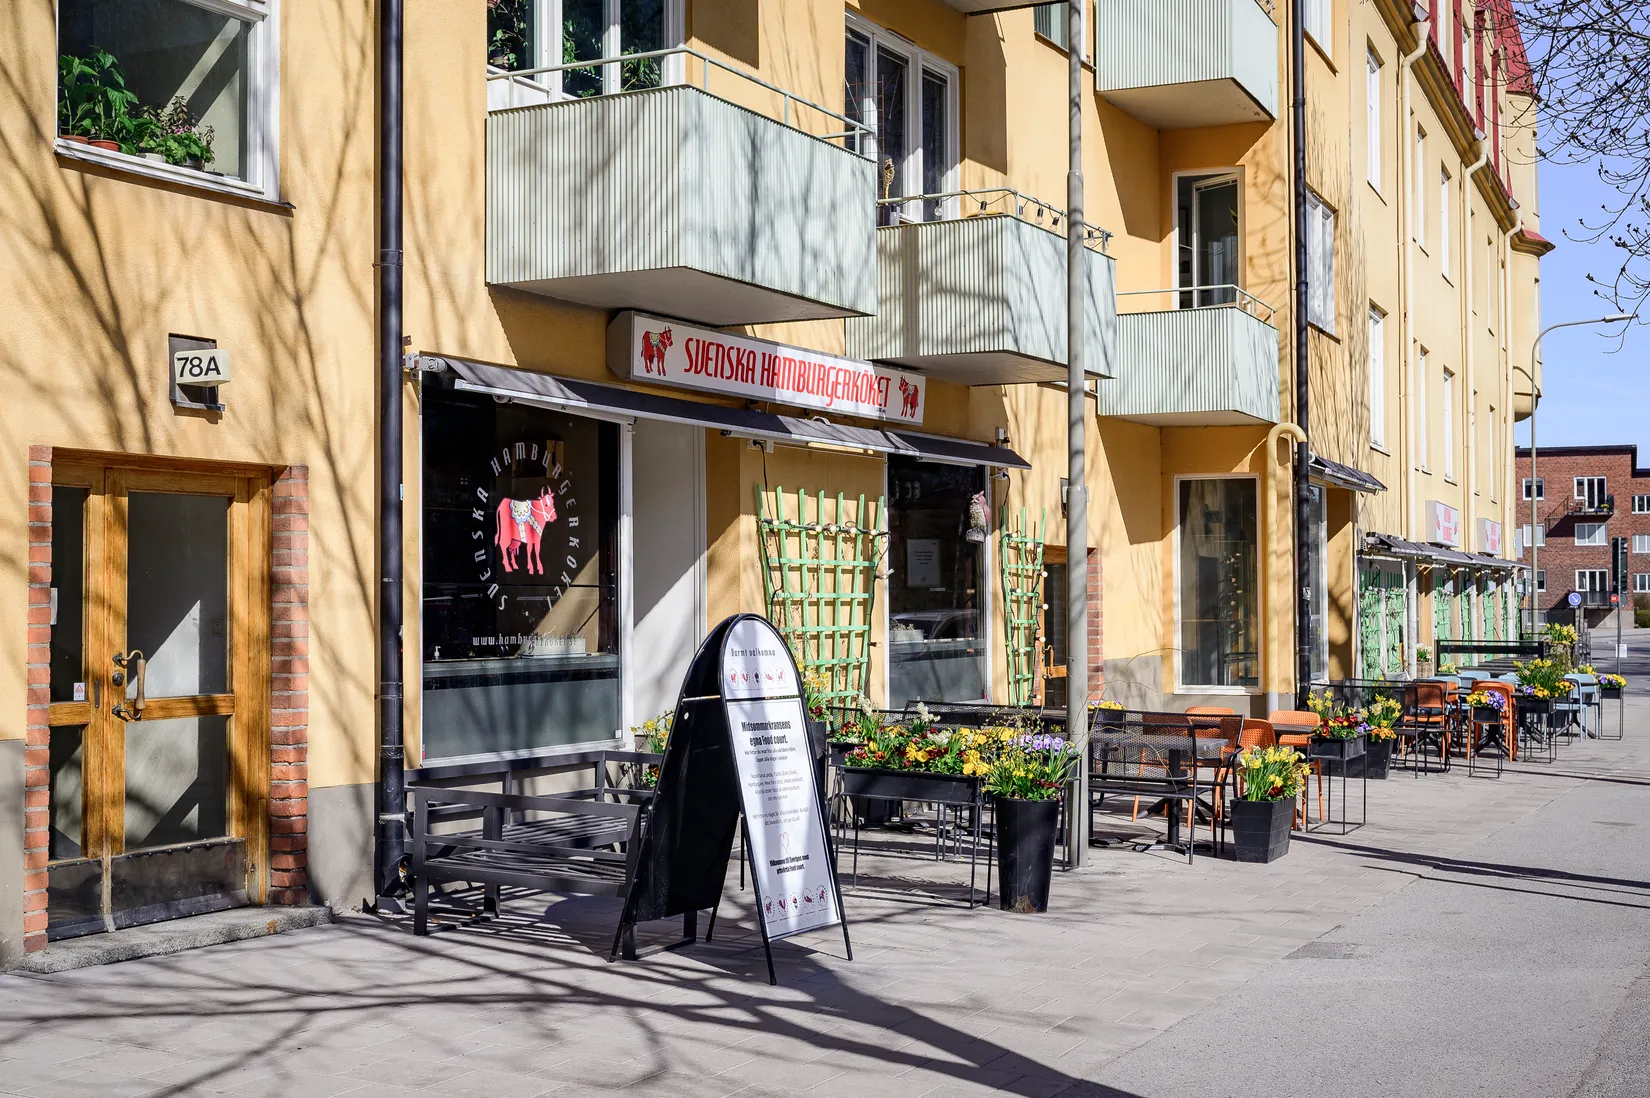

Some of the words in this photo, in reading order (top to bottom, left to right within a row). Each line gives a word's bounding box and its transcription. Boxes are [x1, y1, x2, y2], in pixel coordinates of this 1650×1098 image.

[176, 355, 222, 378] 78A
[683, 337, 756, 386] SVENSKA
[760, 352, 892, 408] HAMBURGERKÖKET
[741, 720, 792, 732] Midsommarkransens
[749, 737, 762, 747] egna
